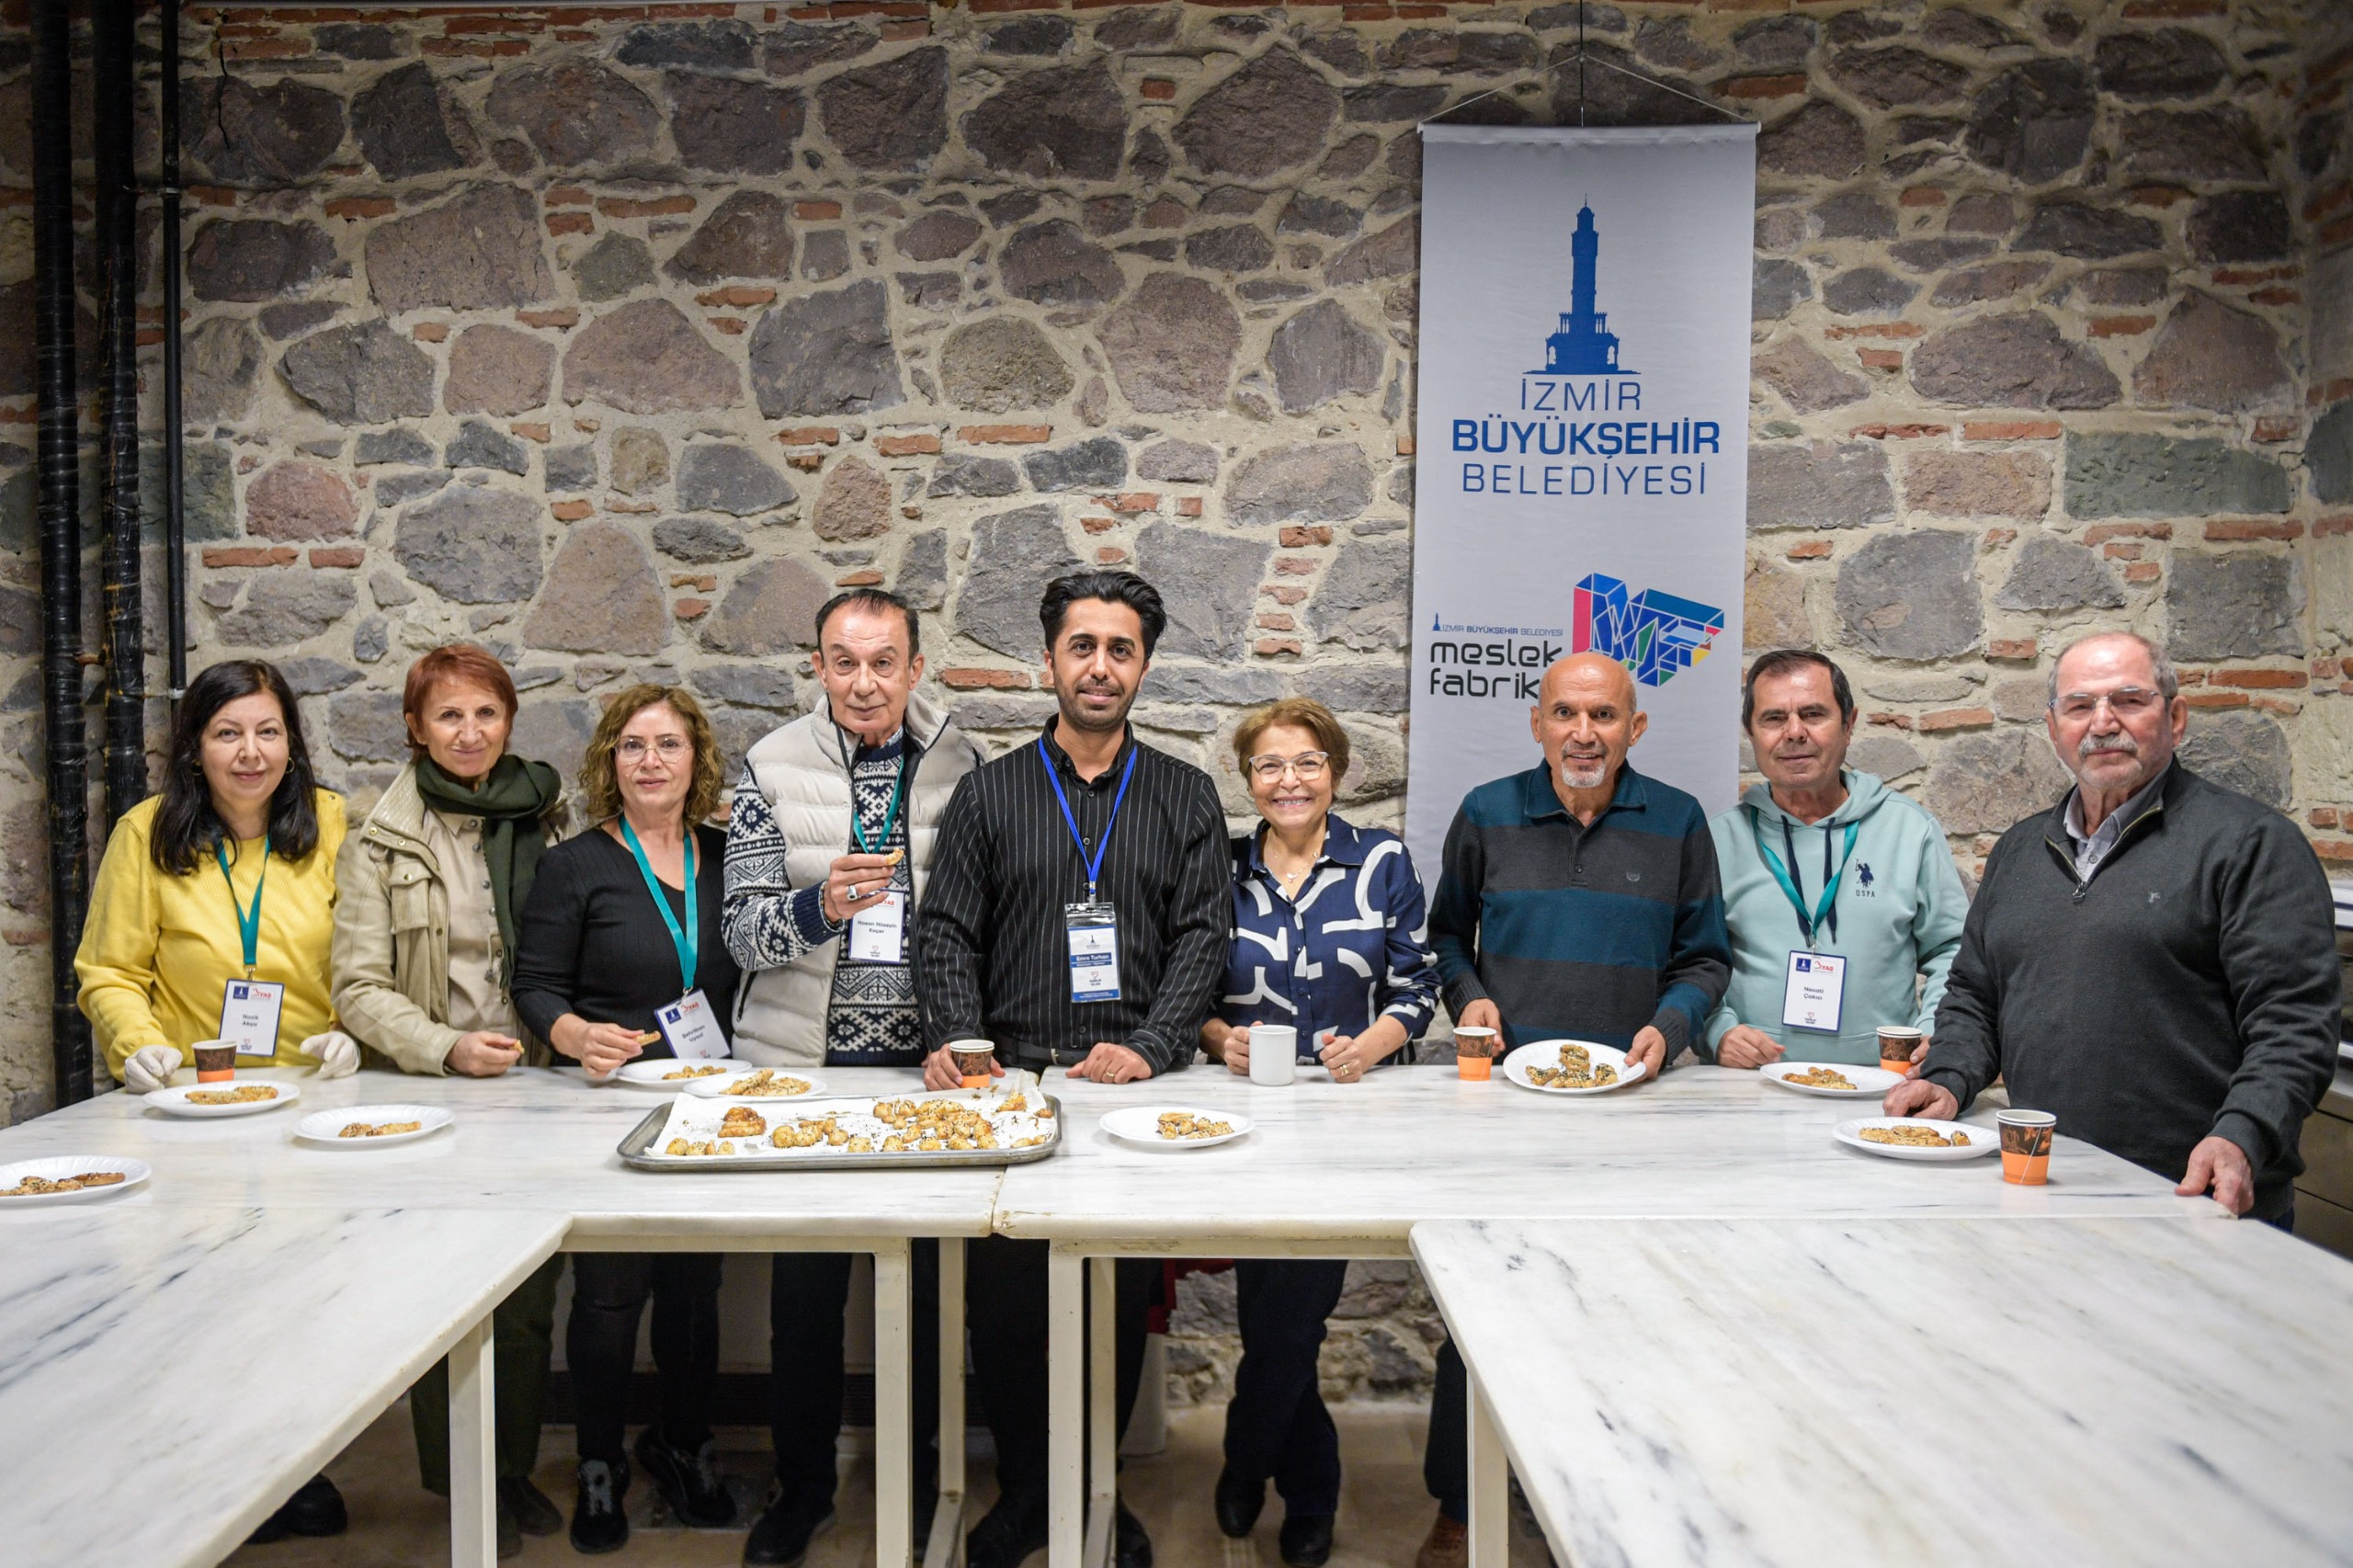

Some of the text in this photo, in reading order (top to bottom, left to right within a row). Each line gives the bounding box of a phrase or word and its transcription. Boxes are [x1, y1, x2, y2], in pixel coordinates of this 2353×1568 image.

[1520, 378, 1642, 412] İZMİR
[1452, 413, 1721, 460] BÜYÜKŞEHİR
[1462, 462, 1705, 495] BELEDİYESİ
[1430, 638, 1563, 668] meslek
